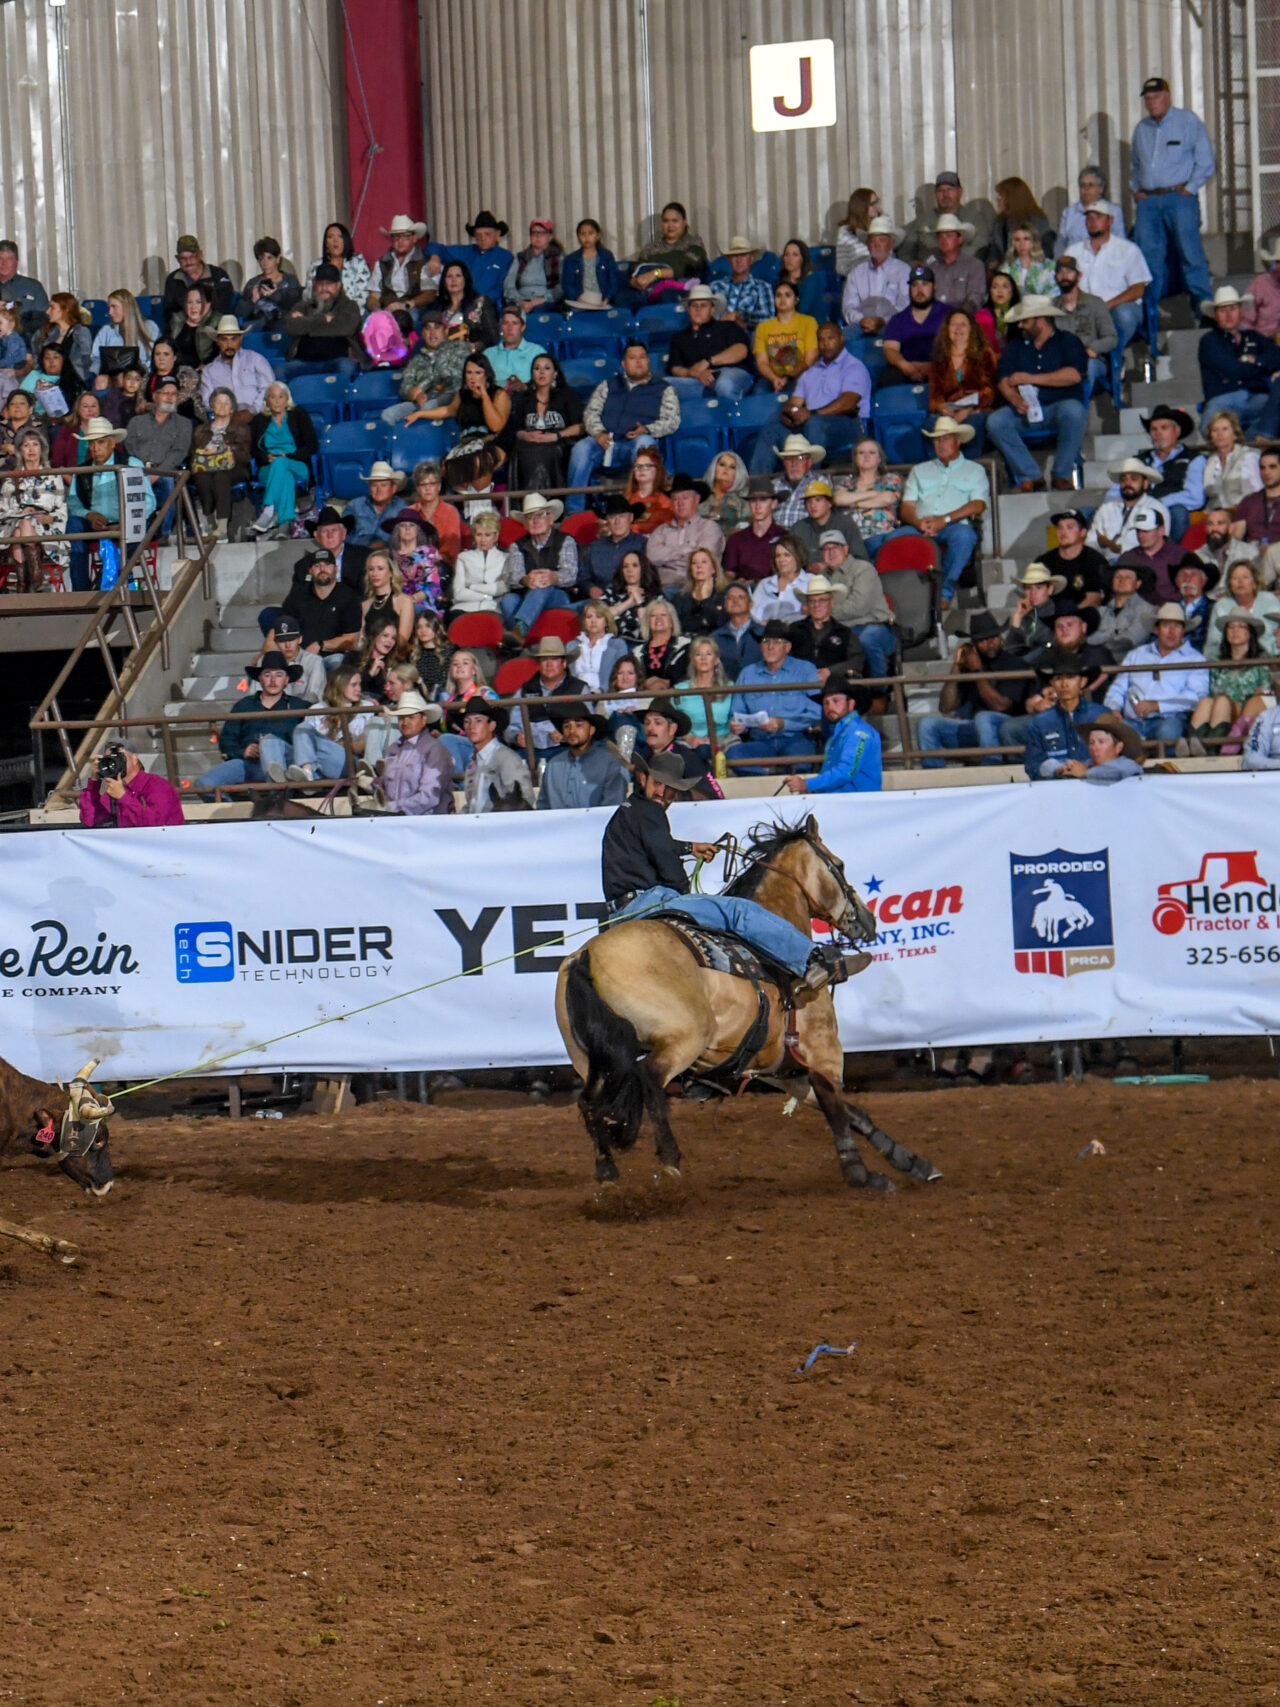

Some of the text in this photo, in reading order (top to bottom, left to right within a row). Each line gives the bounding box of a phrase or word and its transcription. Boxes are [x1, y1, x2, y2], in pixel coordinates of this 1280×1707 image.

[773, 56, 813, 117] J
[1013, 860, 1106, 875] PRORODEO
[1186, 884, 1280, 914] Hend
[912, 921, 955, 941] INC.
[1185, 916, 1251, 931] Tractor
[1257, 914, 1269, 930] &
[27, 919, 139, 977] Rein
[178, 928, 192, 979] tech
[196, 925, 394, 968] SNIDER
[897, 945, 937, 959] TEXAS
[1186, 946, 1280, 965] 325-656
[1070, 955, 1110, 966] PRCA
[240, 965, 393, 982] TECHNOLOGY
[22, 986, 122, 997] COMPANY
